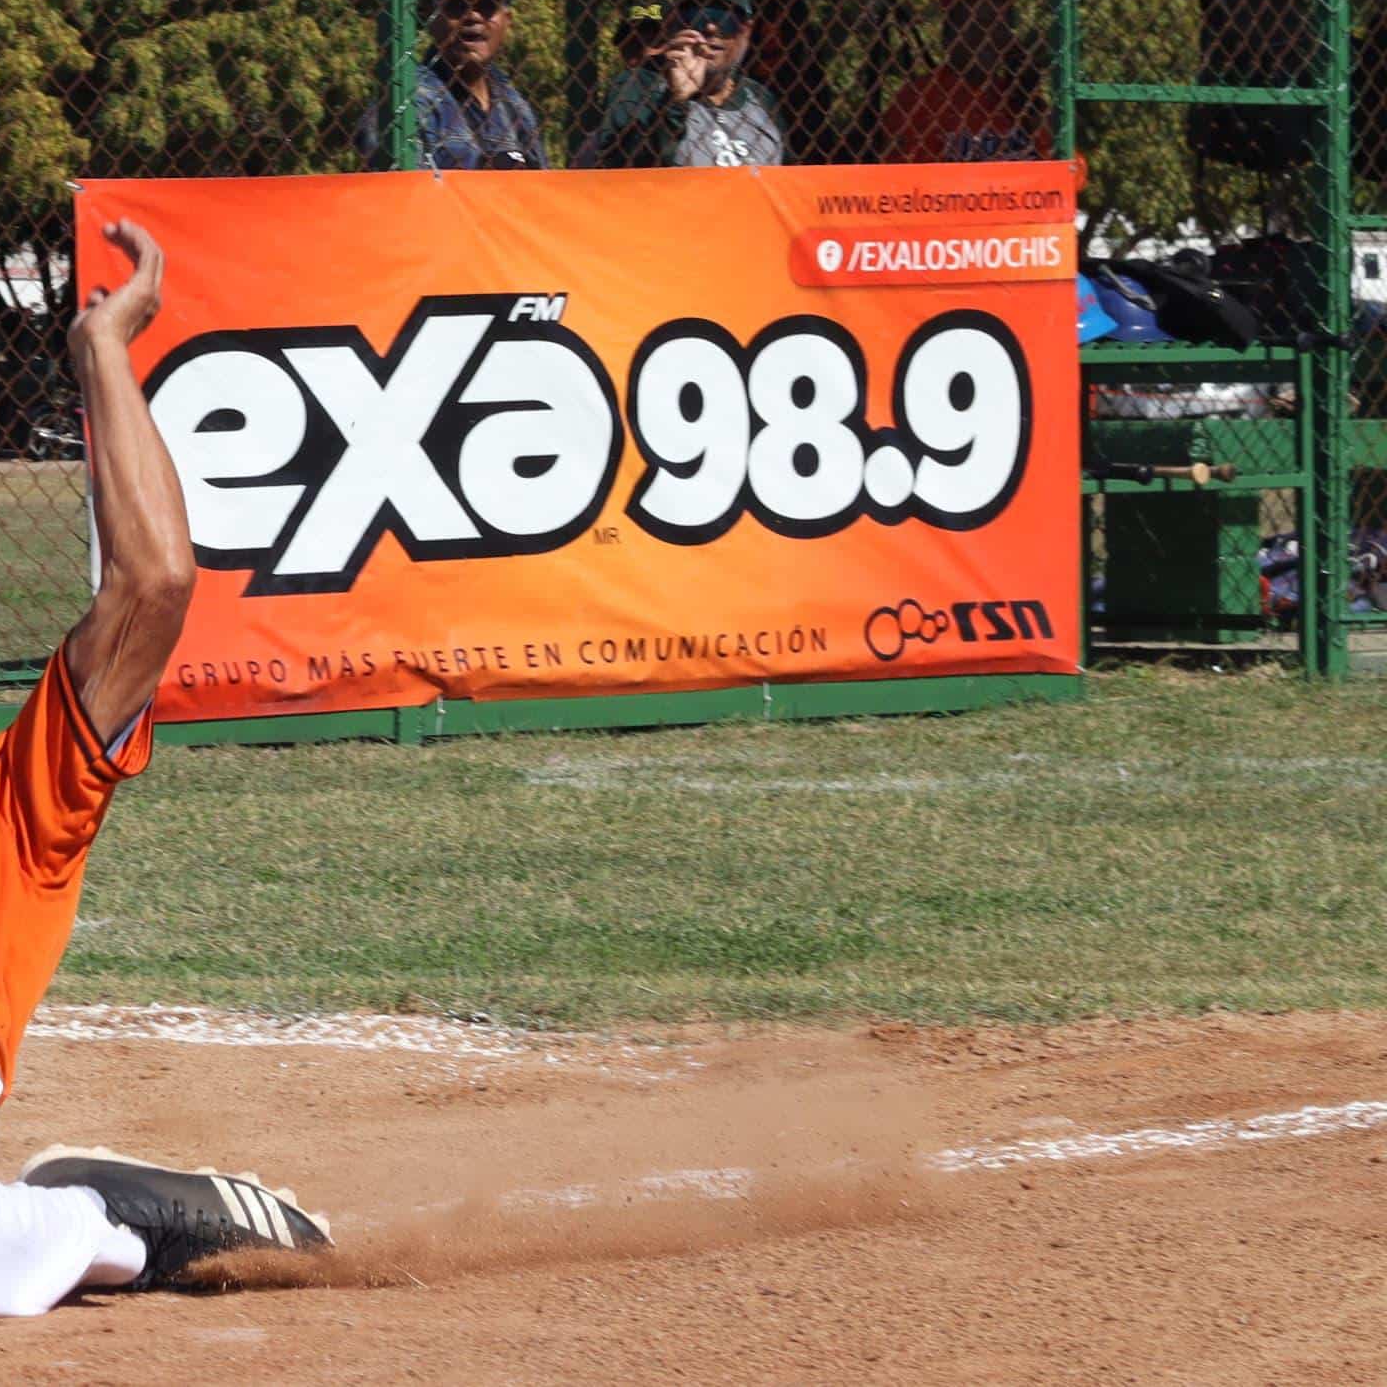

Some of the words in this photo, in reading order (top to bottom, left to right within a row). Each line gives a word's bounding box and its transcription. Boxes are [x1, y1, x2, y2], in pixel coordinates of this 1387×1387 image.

[818, 186, 1063, 215] www.exalosmochis.com
[508, 296, 565, 322] FM
[635, 326, 1023, 528] 98.9
[178, 657, 286, 688] GRUPO
[392, 644, 509, 674] FUERTE
[523, 642, 563, 668] EN
[578, 624, 827, 665] COMUNICACIÓN
